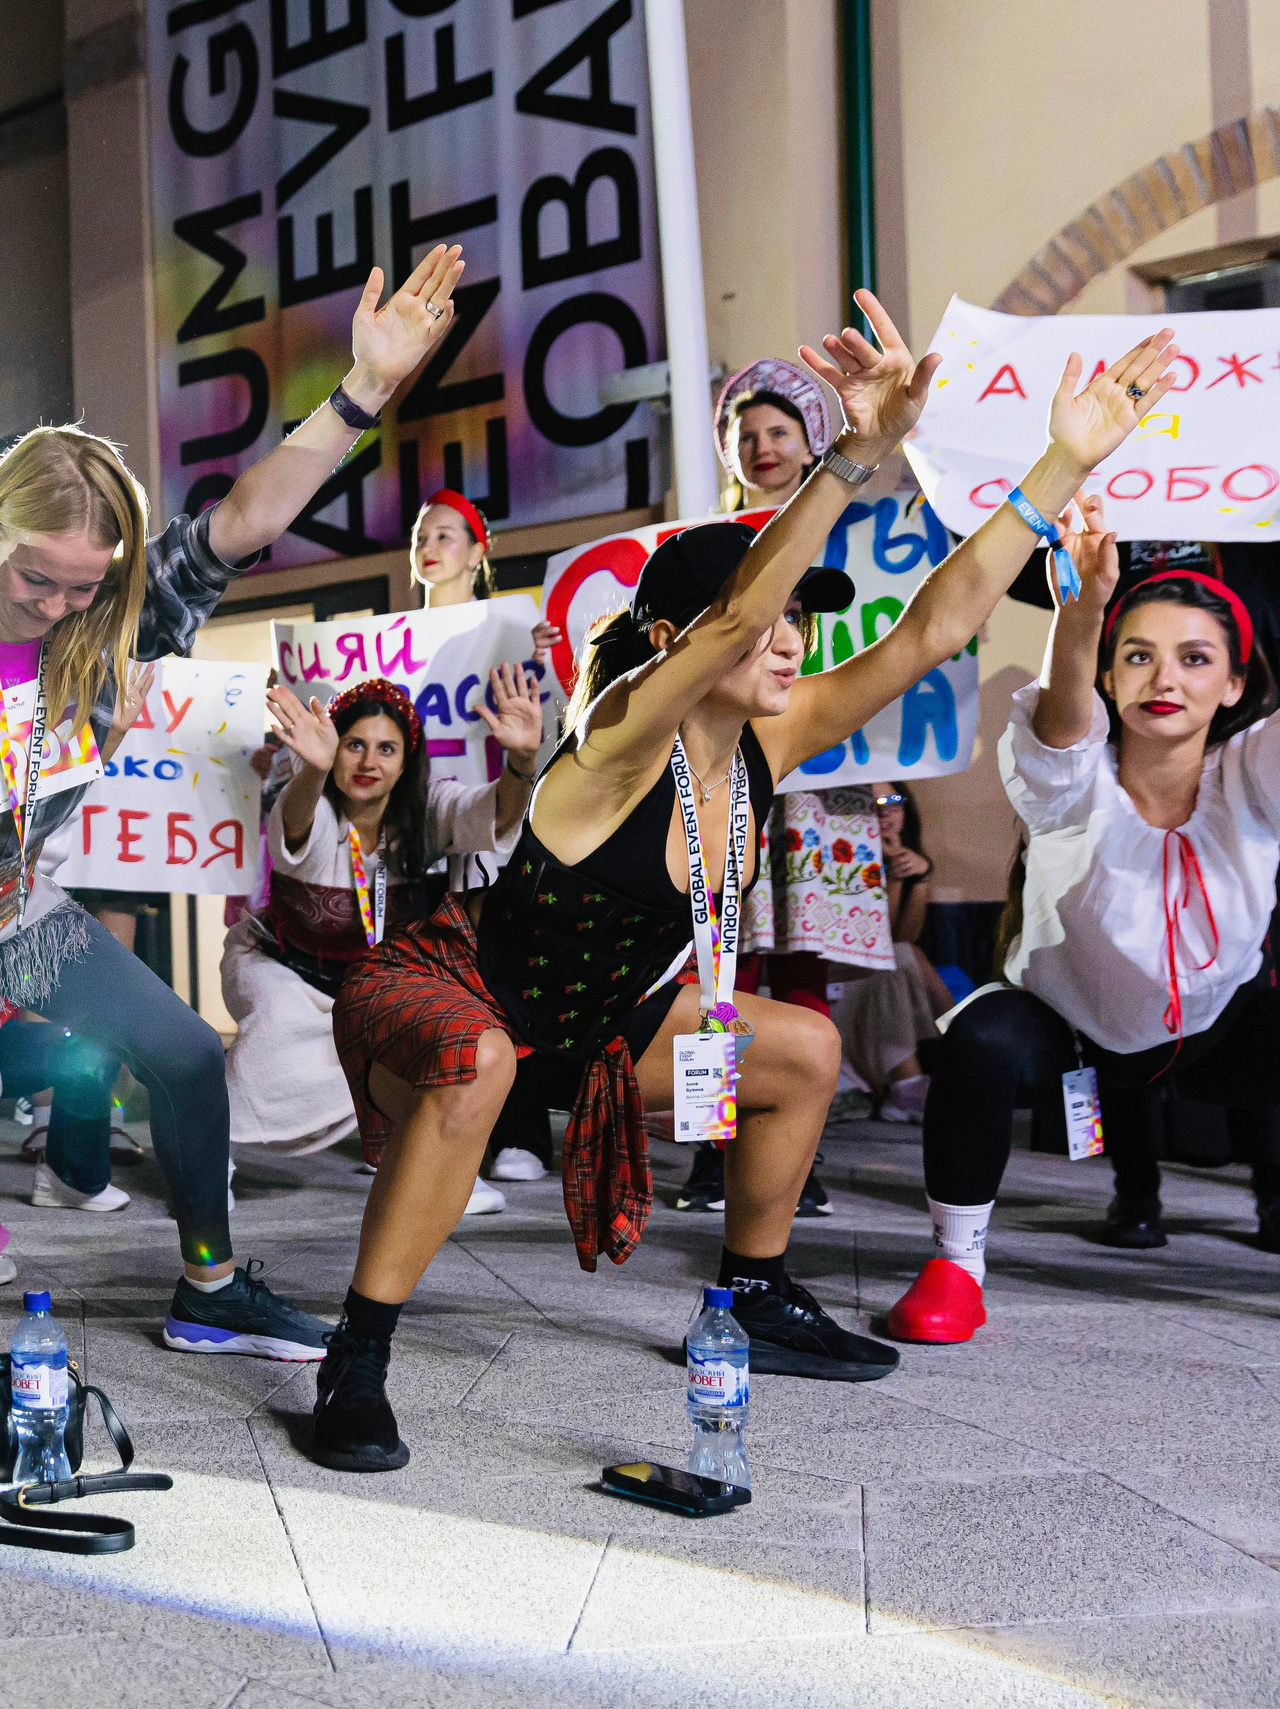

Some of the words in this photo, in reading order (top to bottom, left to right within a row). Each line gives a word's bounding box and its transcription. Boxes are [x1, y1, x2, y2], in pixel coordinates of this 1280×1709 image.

[384, 0, 494, 132] F
[512, 0, 651, 509] OBA
[1133, 412, 1181, 440] Я
[1089, 464, 1280, 502] ОБО
[1018, 501, 1049, 533] EVENT
[32, 705, 48, 758] EVENT
[26, 759, 41, 818] FORUM
[673, 740, 694, 801] FORUM
[683, 804, 701, 855] EVENT
[376, 883, 386, 918] FORUM
[691, 857, 709, 925] GLOBAL
[722, 895, 737, 954] FORUM
